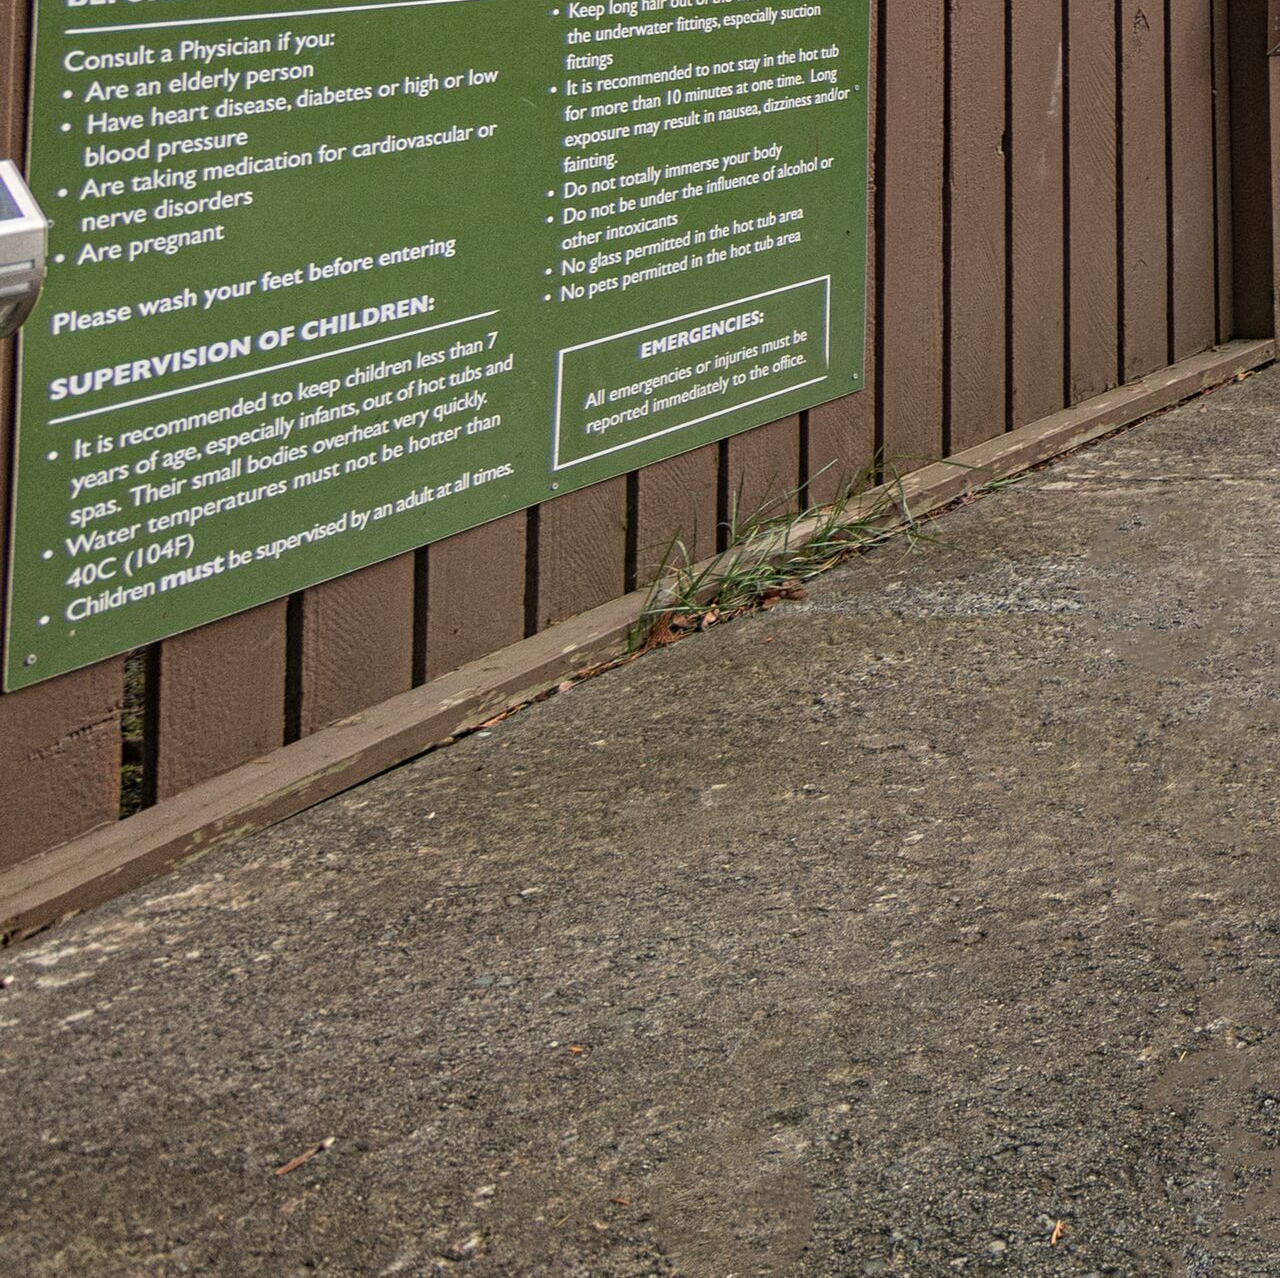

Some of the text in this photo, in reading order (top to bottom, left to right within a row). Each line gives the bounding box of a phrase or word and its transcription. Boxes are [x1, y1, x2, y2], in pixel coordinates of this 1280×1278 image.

[63, 31, 335, 72] Consult a Physician if you:
[566, 4, 821, 45] the underwater fittings, especially suction
[84, 64, 314, 102] Are an elderly person
[565, 52, 613, 71] fittings
[87, 68, 499, 134] Have heart disease, diabetes or high or low
[564, 86, 850, 149] exposure may result in nausea, dizziness and/or
[79, 124, 498, 200] Are taking medication for cardiovascular or
[84, 131, 248, 167] blood pressure
[562, 152, 618, 173] fainting.
[563, 142, 783, 199] Do not totally immerse your body
[81, 190, 253, 232] nerve disorders
[561, 214, 678, 250] other intoxicants
[76, 225, 224, 265] Are pregnant
[51, 238, 456, 335] Please wash your feet before entering
[49, 294, 435, 401] SUPERVISION OF CHILDREN:
[640, 310, 764, 359] EMERGENCIES:
[74, 330, 498, 460] It is recommended to keep children less than 7
[584, 329, 808, 410] All emergencies or injuries must be
[585, 354, 807, 434] reported immediately to the office.
[65, 414, 501, 556] Water temperatures must not be hotter than
[69, 389, 487, 528] spas. Their small bodies overheat very quickly.
[65, 533, 195, 588] 40C (104F)
